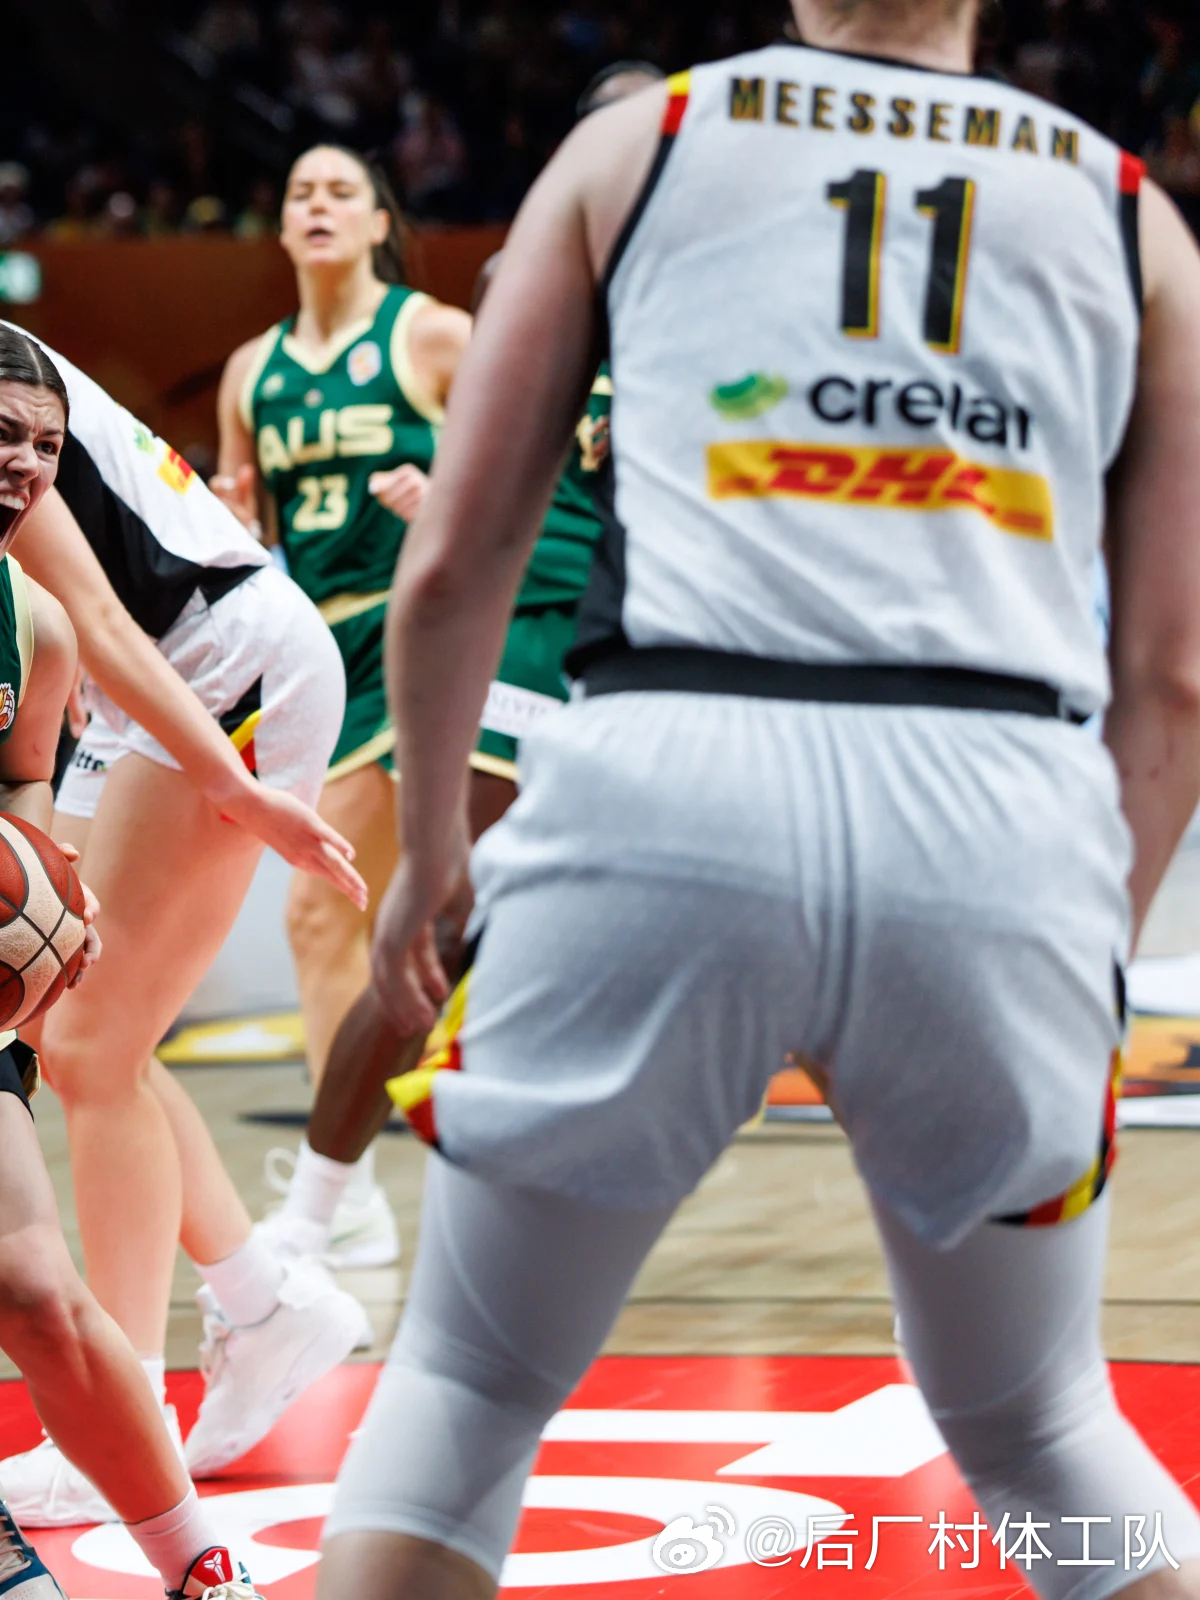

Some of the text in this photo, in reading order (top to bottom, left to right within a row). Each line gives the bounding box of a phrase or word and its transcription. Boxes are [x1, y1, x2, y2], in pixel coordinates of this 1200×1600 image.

[729, 76, 1079, 166] MEESSEMAN
[826, 168, 977, 356] 11
[257, 403, 393, 478] AUS
[292, 474, 349, 532] 23
[767, 447, 996, 516] DHL
